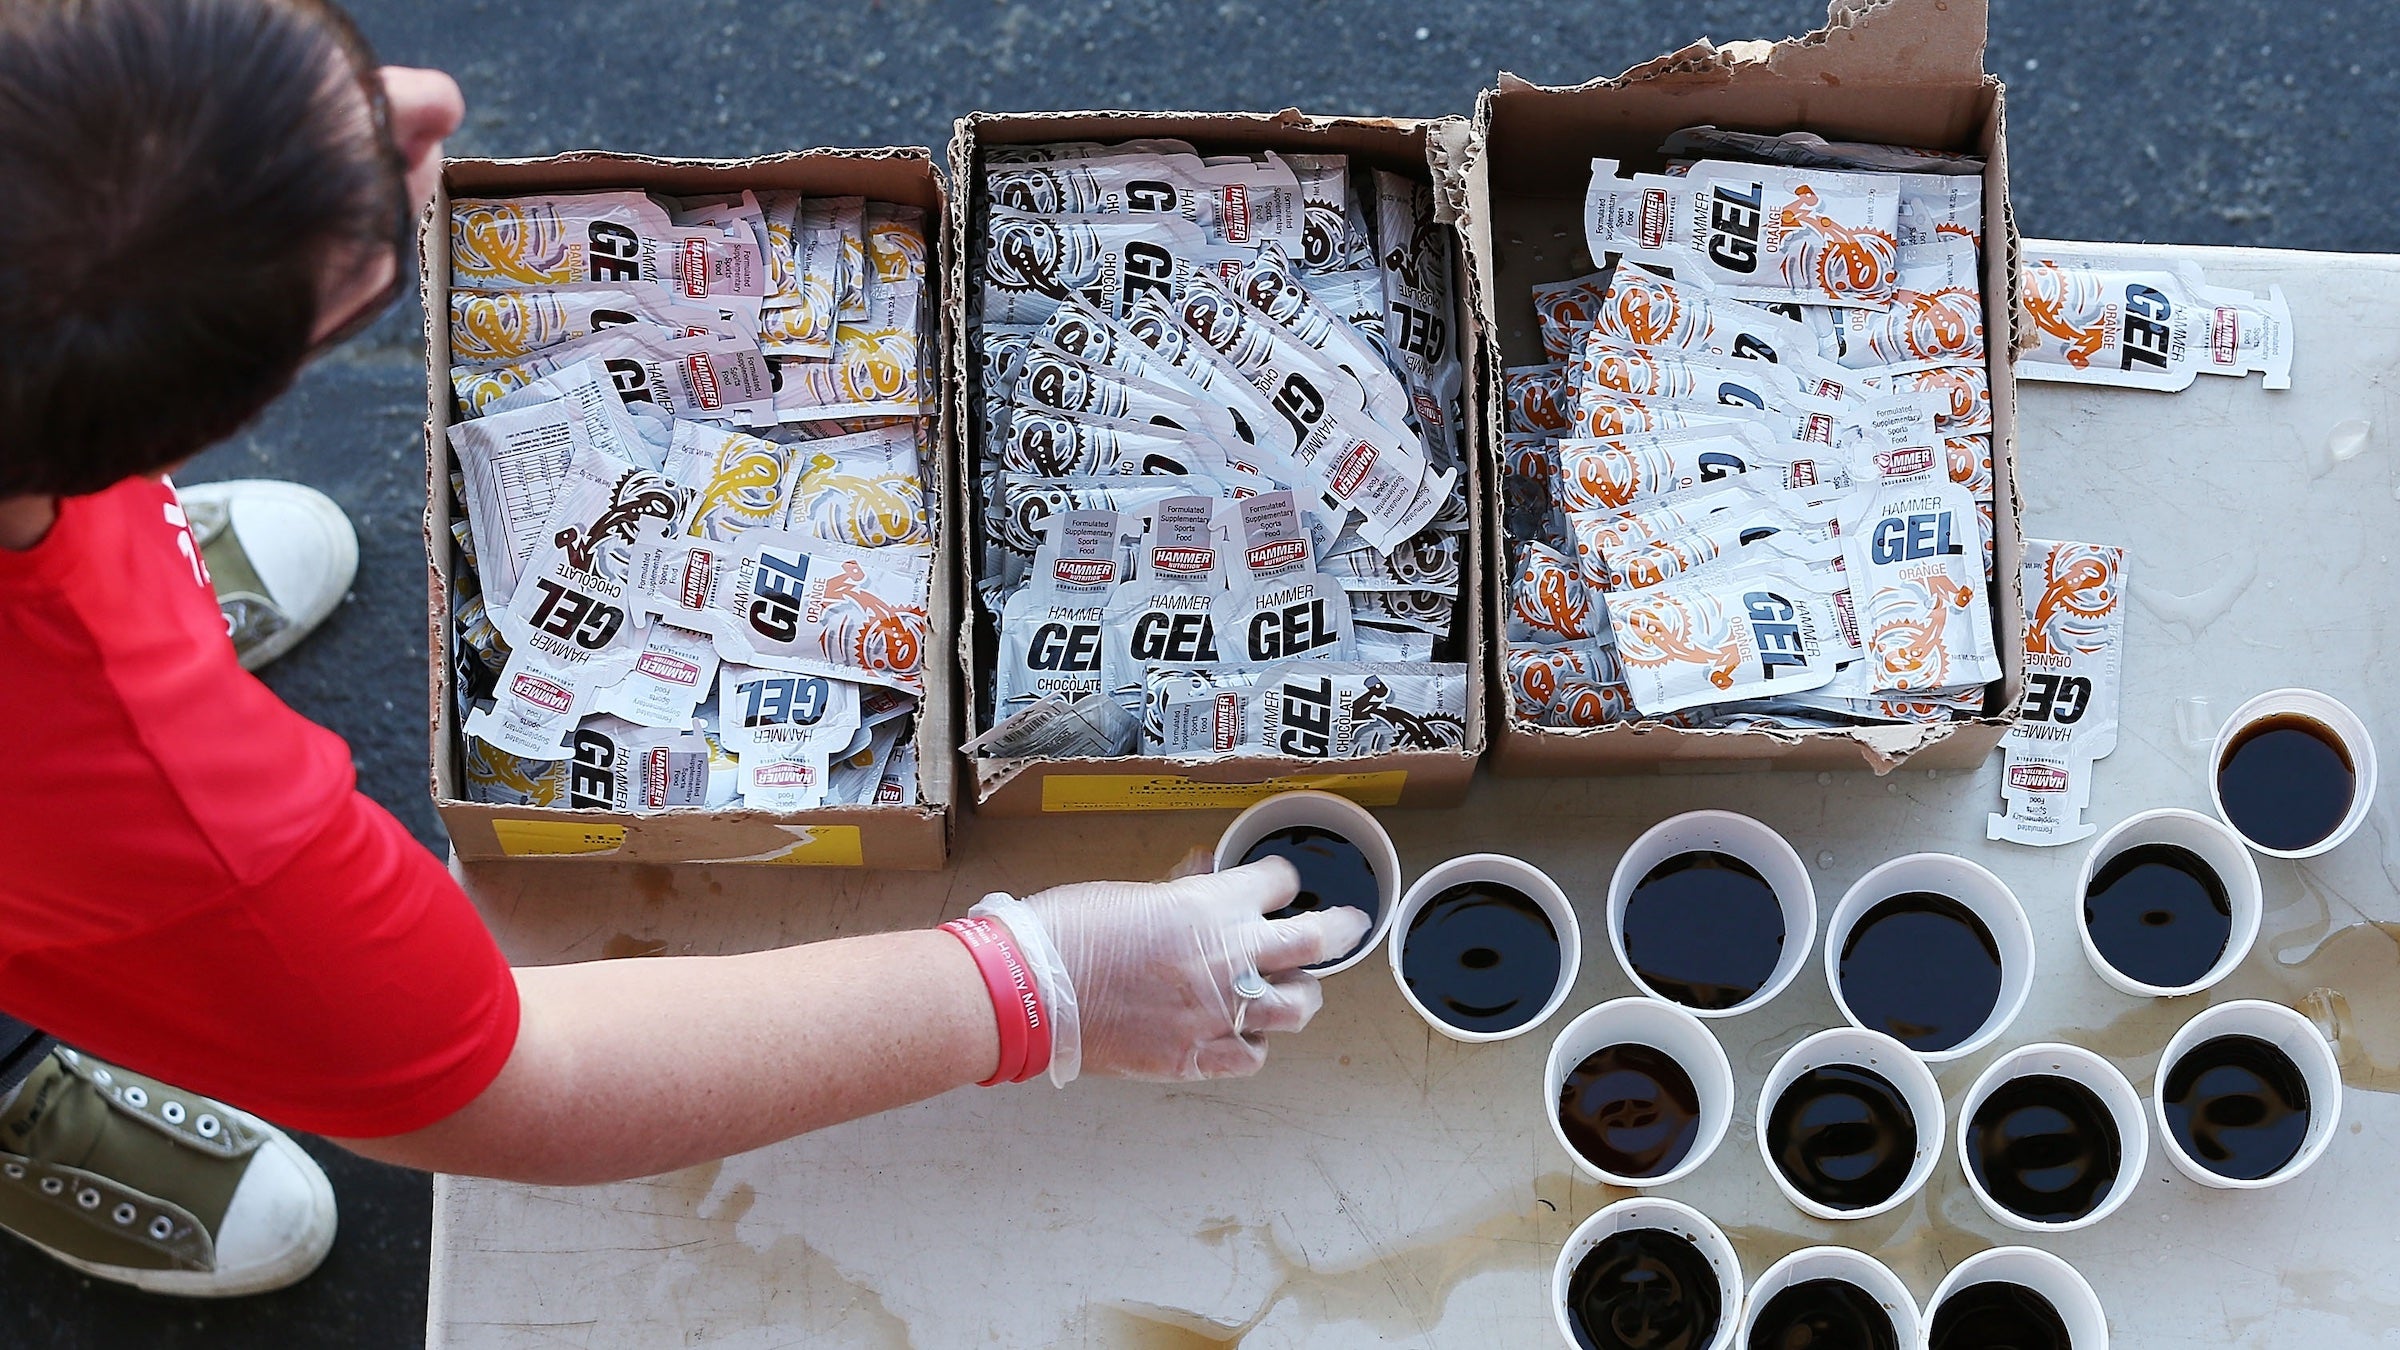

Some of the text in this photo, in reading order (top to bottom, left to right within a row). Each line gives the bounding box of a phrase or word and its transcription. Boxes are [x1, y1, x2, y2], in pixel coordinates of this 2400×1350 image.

[1231, 188, 1246, 239] HAMMER
[1255, 205, 1263, 220] Food
[1264, 202, 1273, 222] Sports
[1272, 187, 1282, 235] Supplementary
[1285, 192, 1293, 229] Formulated
[1595, 198, 1606, 235] Formulated
[1606, 192, 1618, 241] Supplementary
[1615, 207, 1624, 228] Sports
[1625, 209, 1635, 227] Food
[1643, 191, 1660, 247] HAMMER
[1691, 192, 1710, 253] HAMMER
[1709, 181, 1765, 274] GEL
[1766, 205, 1783, 253] ORANGE
[569, 243, 582, 282] BANAN
[589, 221, 640, 281] GE
[692, 241, 704, 295] HAMMER
[733, 244, 741, 293] Supplementary
[1391, 300, 1446, 364] GEL
[2104, 303, 2118, 350] ORANGE
[2121, 283, 2172, 372] GEL
[2171, 306, 2190, 363] HAMMER
[2221, 310, 2235, 362] HAMMER
[2253, 327, 2261, 348] Sports
[2262, 315, 2273, 360] Supplementary
[2272, 321, 2280, 357] Formulated
[696, 357, 717, 406] HAMMER
[721, 370, 732, 386] Food
[730, 366, 740, 387] Sports
[737, 352, 754, 398] Supplementary
[747, 356, 762, 392] Formulated
[1872, 413, 1921, 429] Supplementary
[1876, 405, 1913, 417] Formulated
[1887, 426, 1908, 435] Sports
[1891, 435, 1908, 445] Food
[1339, 447, 1376, 496] HAMMER
[1367, 477, 1380, 492] Food
[1372, 480, 1389, 499] Sports
[1372, 475, 1405, 516] Supplementary
[1384, 486, 1409, 519] Formulated
[1072, 519, 1109, 528] Formulated
[1167, 506, 1205, 514] Formulated
[1245, 509, 1293, 523] Supplementary
[1249, 500, 1286, 514] Formulated
[1882, 497, 1942, 517] HAMMER
[1065, 528, 1114, 538] Supplementary
[1174, 525, 1196, 533] Sports
[1260, 520, 1282, 529] Sports
[1264, 529, 1281, 538] Food
[1871, 511, 1964, 565] GEL
[1077, 537, 1099, 546] Sports
[1156, 551, 1210, 563] HAMMER
[1250, 543, 1303, 563] HAMMER
[555, 563, 623, 598] CHOCOLATE
[638, 552, 651, 590] Formulated
[647, 548, 663, 597] Supplementary
[658, 563, 669, 586] Sports
[668, 568, 678, 584] Food
[685, 552, 706, 608] HAMMER
[1057, 561, 1112, 575] HAMMER
[1899, 563, 1947, 580] ORANGE
[732, 557, 756, 618] HAMMER
[750, 552, 811, 643] GEL
[807, 577, 827, 624] ORANGE
[1150, 595, 1211, 610] HAMMER
[1256, 584, 1314, 610] HAMMER
[529, 577, 625, 650] GEL
[1249, 598, 1338, 662] GEL
[1793, 600, 1821, 658] HAMMER
[529, 631, 591, 665] HAMMER
[1730, 616, 1754, 663] ORANGE
[1743, 592, 1808, 680] GEL
[641, 660, 696, 684] HAMMER
[2025, 653, 2072, 668] ORANGE
[514, 680, 569, 710] HAMMER
[649, 694, 672, 705] Sports
[652, 685, 671, 695] Food
[1037, 678, 1100, 692] CHOCOLATE
[2022, 673, 2092, 725] GE
[525, 709, 543, 719] Food
[633, 698, 681, 718] Supplementary
[635, 707, 673, 724] Formulated
[735, 677, 830, 728] GEL
[1263, 690, 1280, 748] HAMMER
[1280, 674, 1333, 758] GEL
[502, 720, 550, 745] Supplementary
[519, 716, 542, 729] Sports
[753, 728, 813, 744] HAMMER
[1172, 710, 1181, 747] Formulated
[1181, 703, 1191, 751] Supplementary
[1191, 715, 1199, 736] Sports
[1217, 696, 1229, 750] HAMMER
[1336, 690, 1352, 753] CHOCOLATE
[2012, 724, 2072, 742] HAMMER
[503, 733, 541, 752] Formulated
[554, 760, 564, 800] ANANA
[615, 747, 631, 810] HAMMER
[654, 750, 667, 807] HAMMER
[685, 754, 696, 804] Supplementary
[695, 759, 703, 798] Formulated
[756, 772, 814, 784] HAMMER
[2012, 772, 2066, 789] HAMMER
[2026, 806, 2047, 815] Sports
[2029, 796, 2046, 804] Food
[2012, 812, 2060, 824] Supplementary
[2017, 823, 2053, 834] Formulated
[998, 941, 1029, 990] Healthy
[1022, 992, 1040, 1029] Mum
